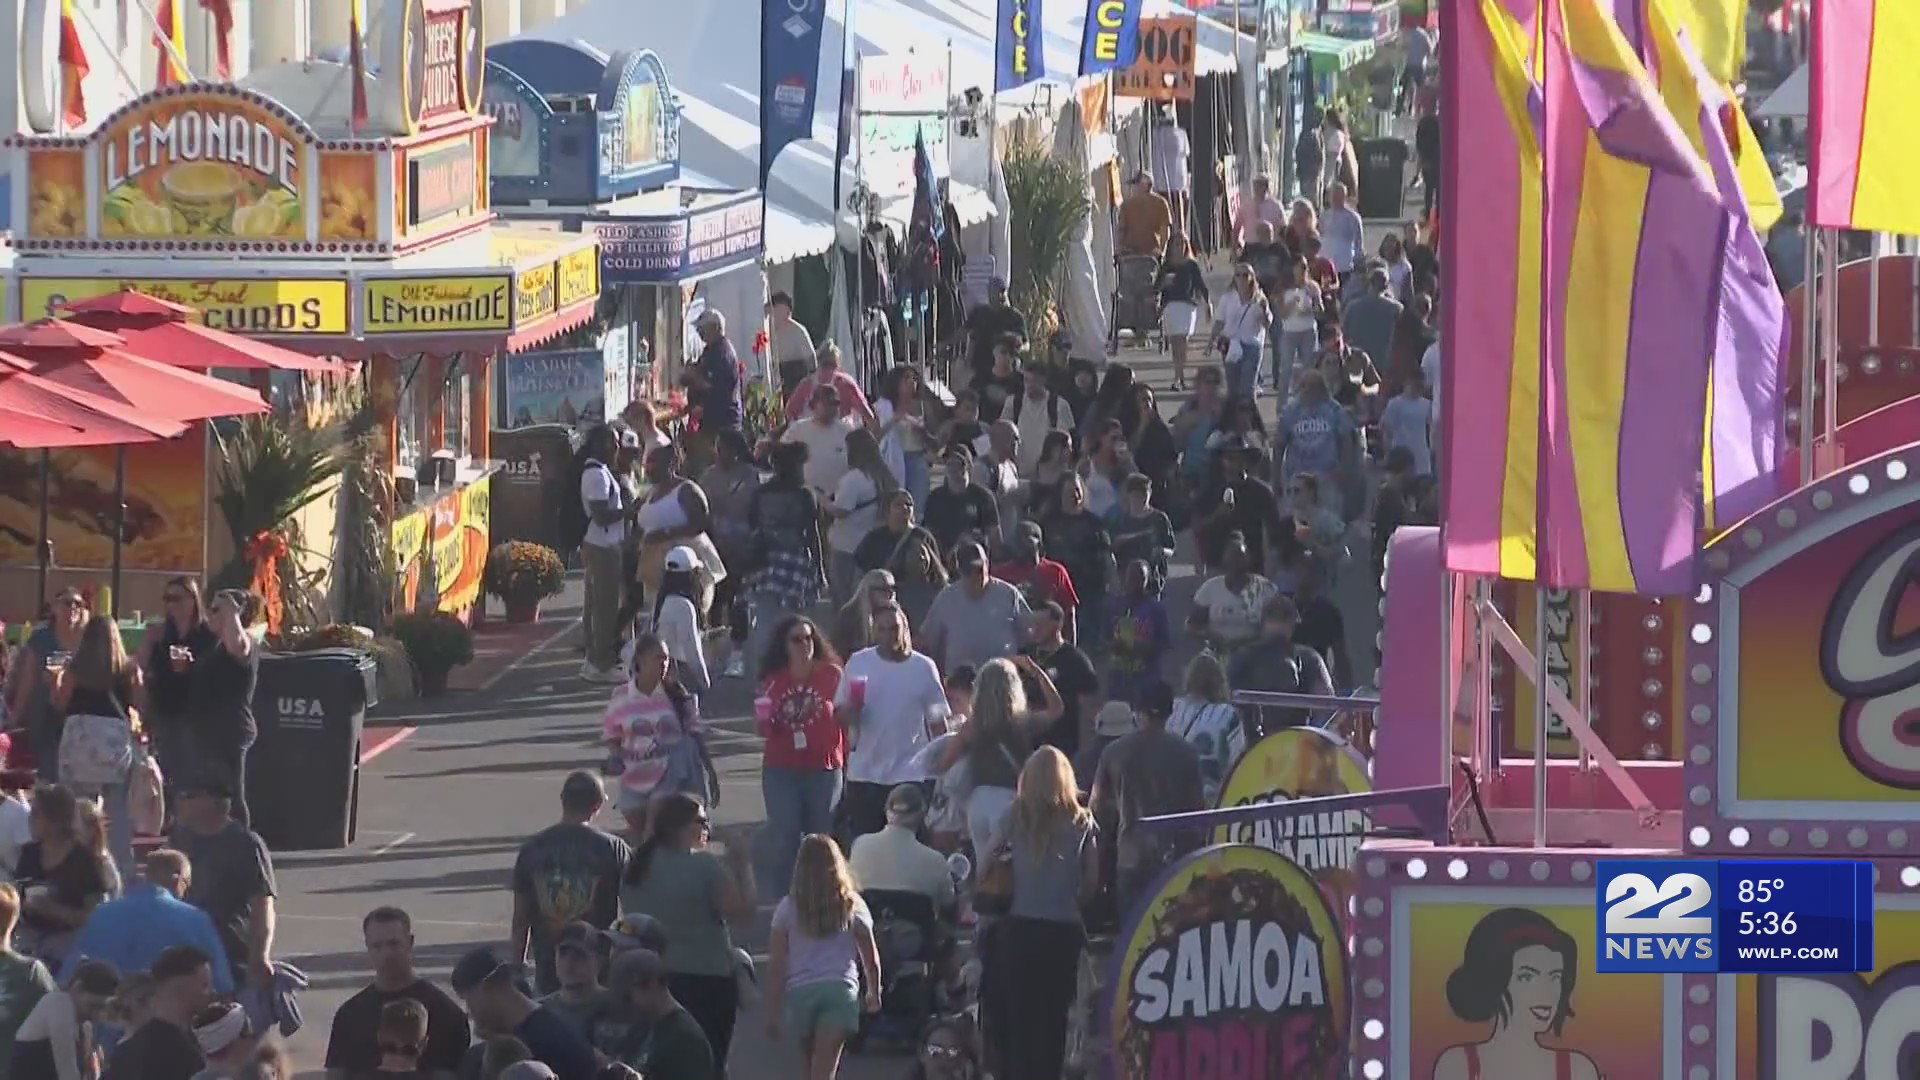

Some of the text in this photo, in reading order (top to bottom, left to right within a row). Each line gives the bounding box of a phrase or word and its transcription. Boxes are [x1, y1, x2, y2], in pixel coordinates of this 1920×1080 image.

[107, 110, 298, 197] LEMONADE
[605, 257, 642, 269] COLD
[203, 298, 321, 330] CURDS
[368, 284, 505, 324] LEMONADE
[506, 460, 541, 475] USA
[278, 697, 325, 716] USA
[1134, 918, 1324, 1023] SAMOA
